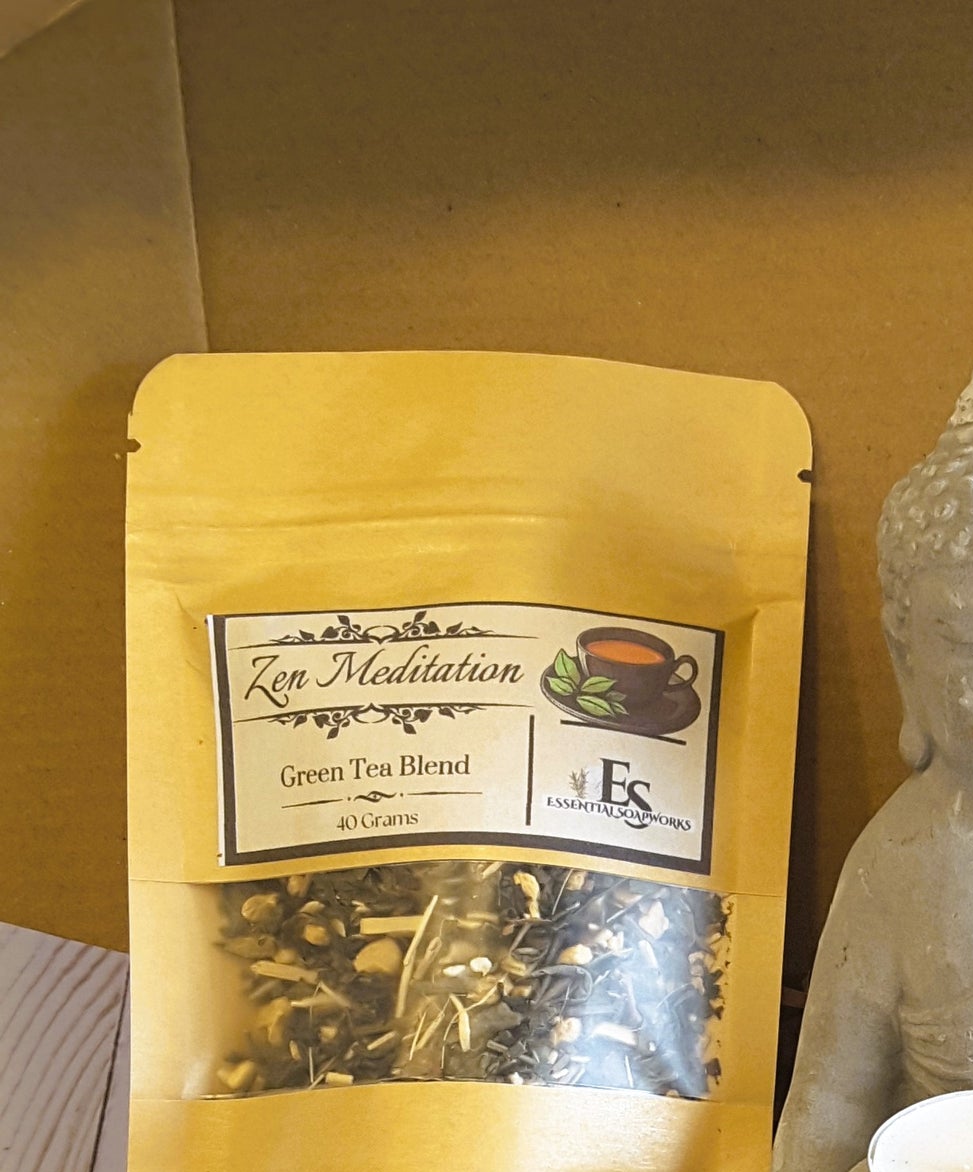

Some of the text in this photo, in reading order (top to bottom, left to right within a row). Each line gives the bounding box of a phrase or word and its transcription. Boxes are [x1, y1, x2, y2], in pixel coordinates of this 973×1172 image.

[244, 643, 525, 708] Zen Meditation
[280, 754, 470, 789] Green Tea Blend
[336, 810, 419, 831] 40 Grams
